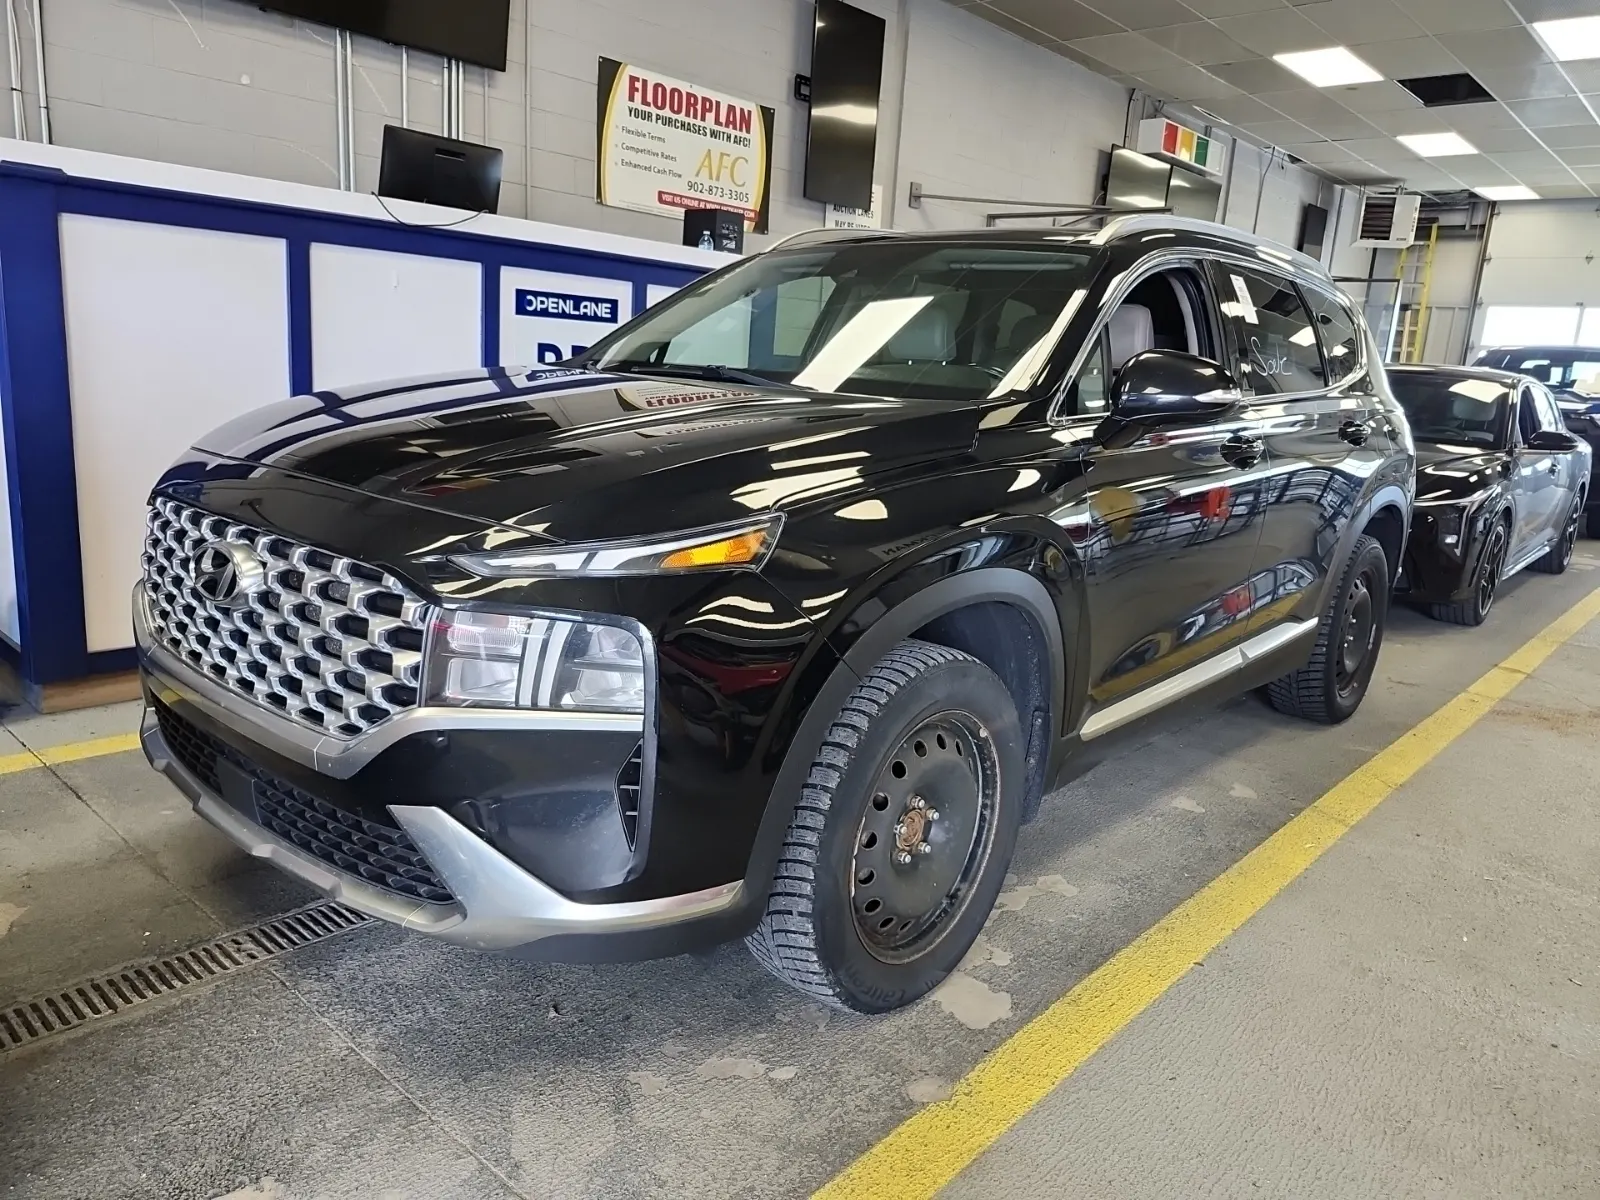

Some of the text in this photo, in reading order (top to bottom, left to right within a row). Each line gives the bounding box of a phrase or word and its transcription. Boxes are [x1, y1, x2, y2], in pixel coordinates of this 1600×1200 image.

[628, 74, 752, 134] FLOORPLAN
[621, 126, 666, 143] Flexible Terms
[627, 106, 751, 148] YOUR PURCHASES WITH AFC!
[621, 142, 677, 162] Competitive Rates
[621, 158, 682, 178] Enhanced Cash Flow
[695, 148, 748, 187] AFC
[687, 180, 749, 203] 902-873-3305
[526, 295, 611, 318] OPENLANE
